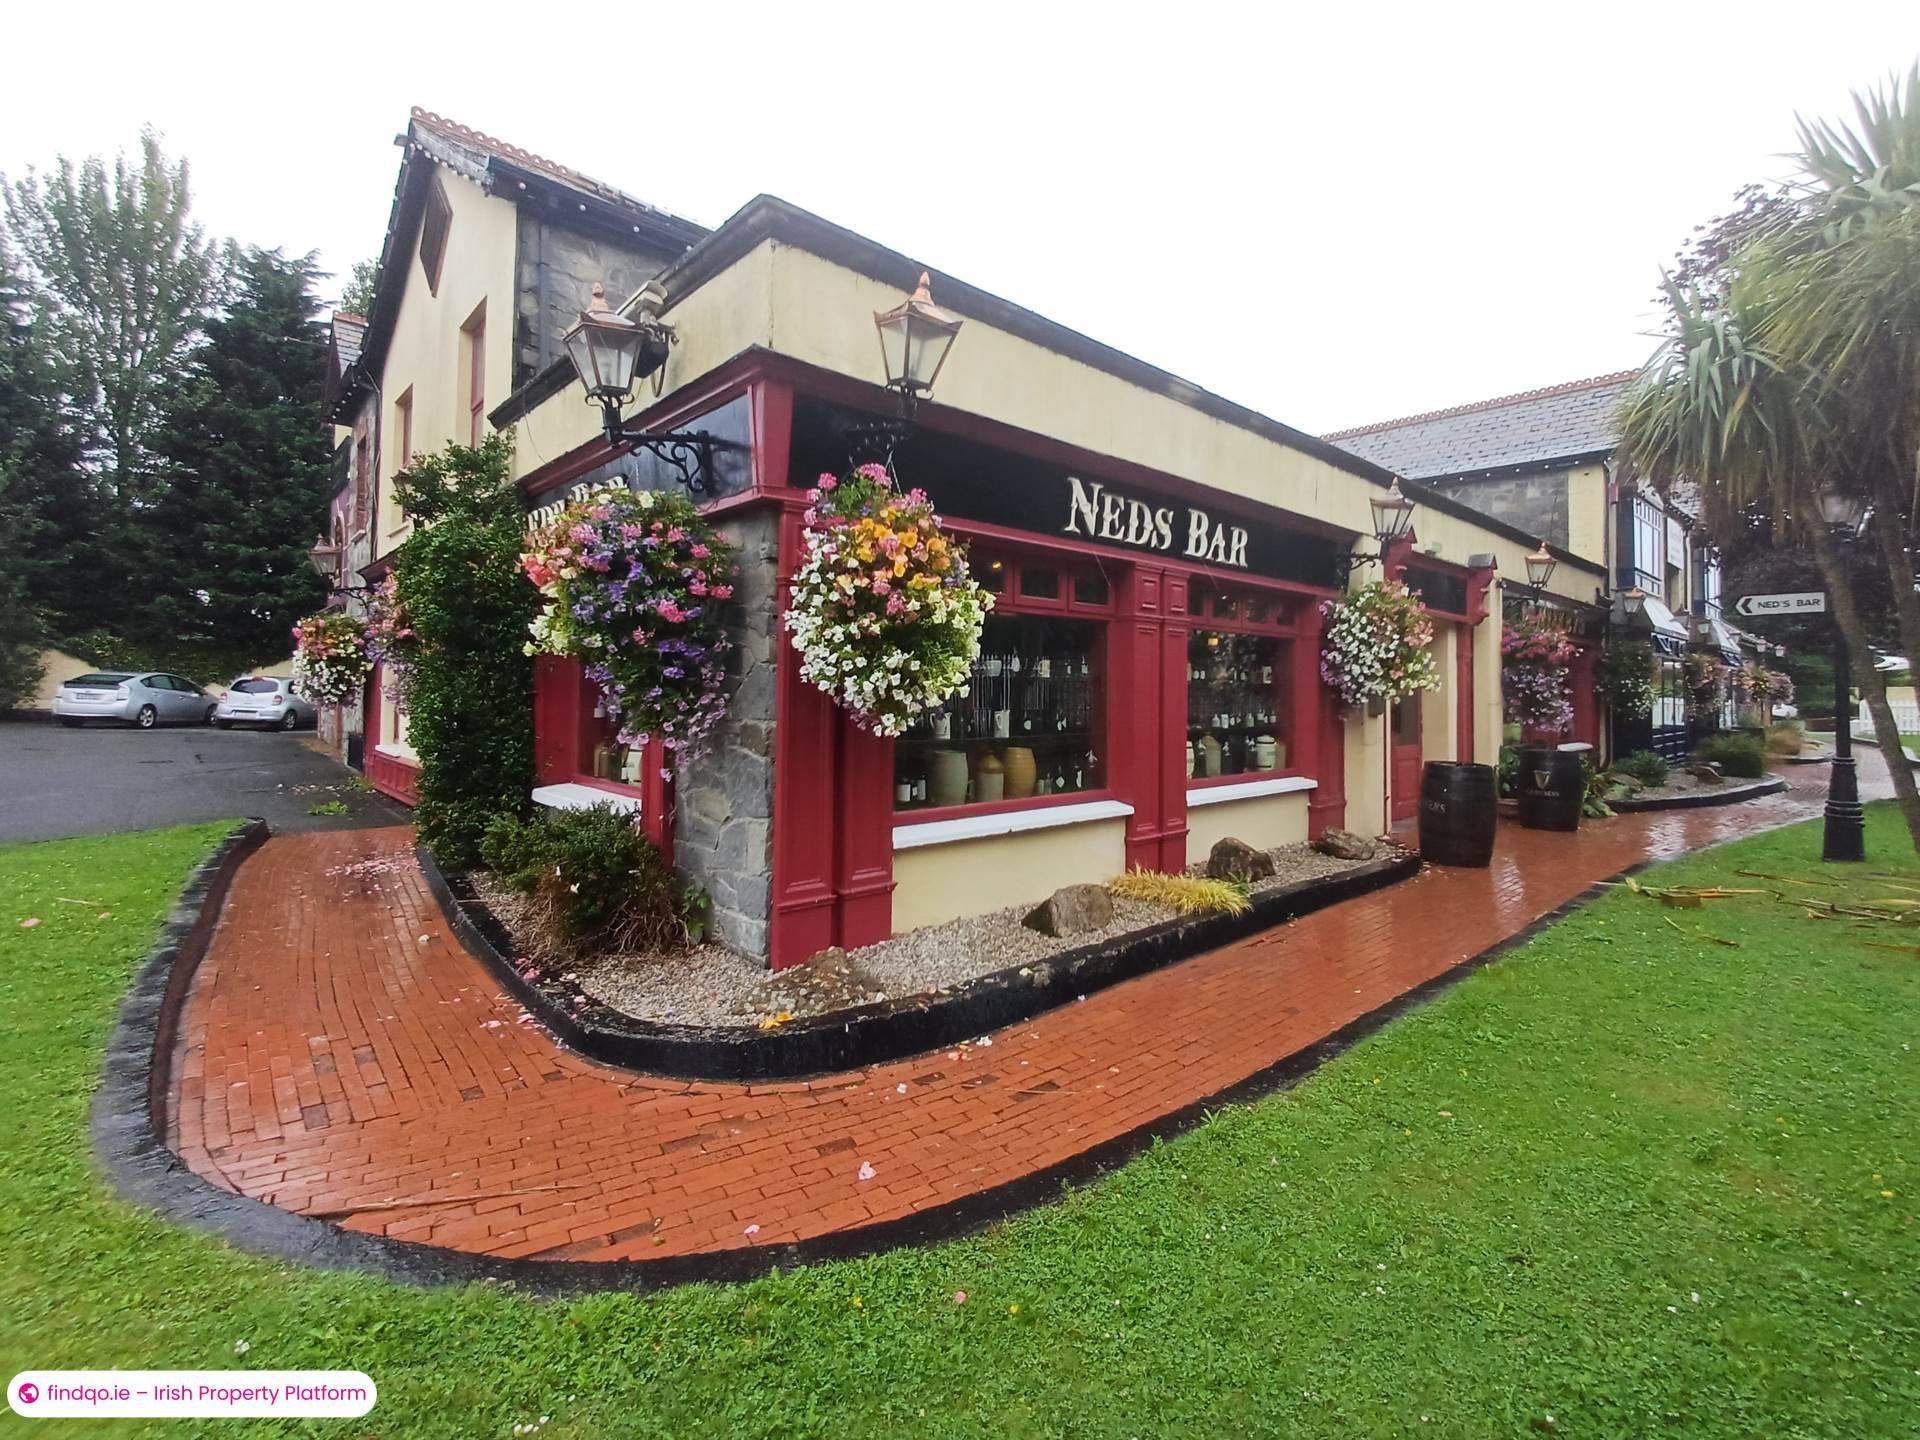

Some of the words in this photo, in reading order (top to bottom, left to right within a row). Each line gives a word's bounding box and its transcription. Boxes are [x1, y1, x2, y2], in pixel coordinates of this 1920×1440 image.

[1064, 476, 1174, 550] NEDS
[1184, 508, 1248, 568] BAR
[1796, 599, 1821, 608] BAR
